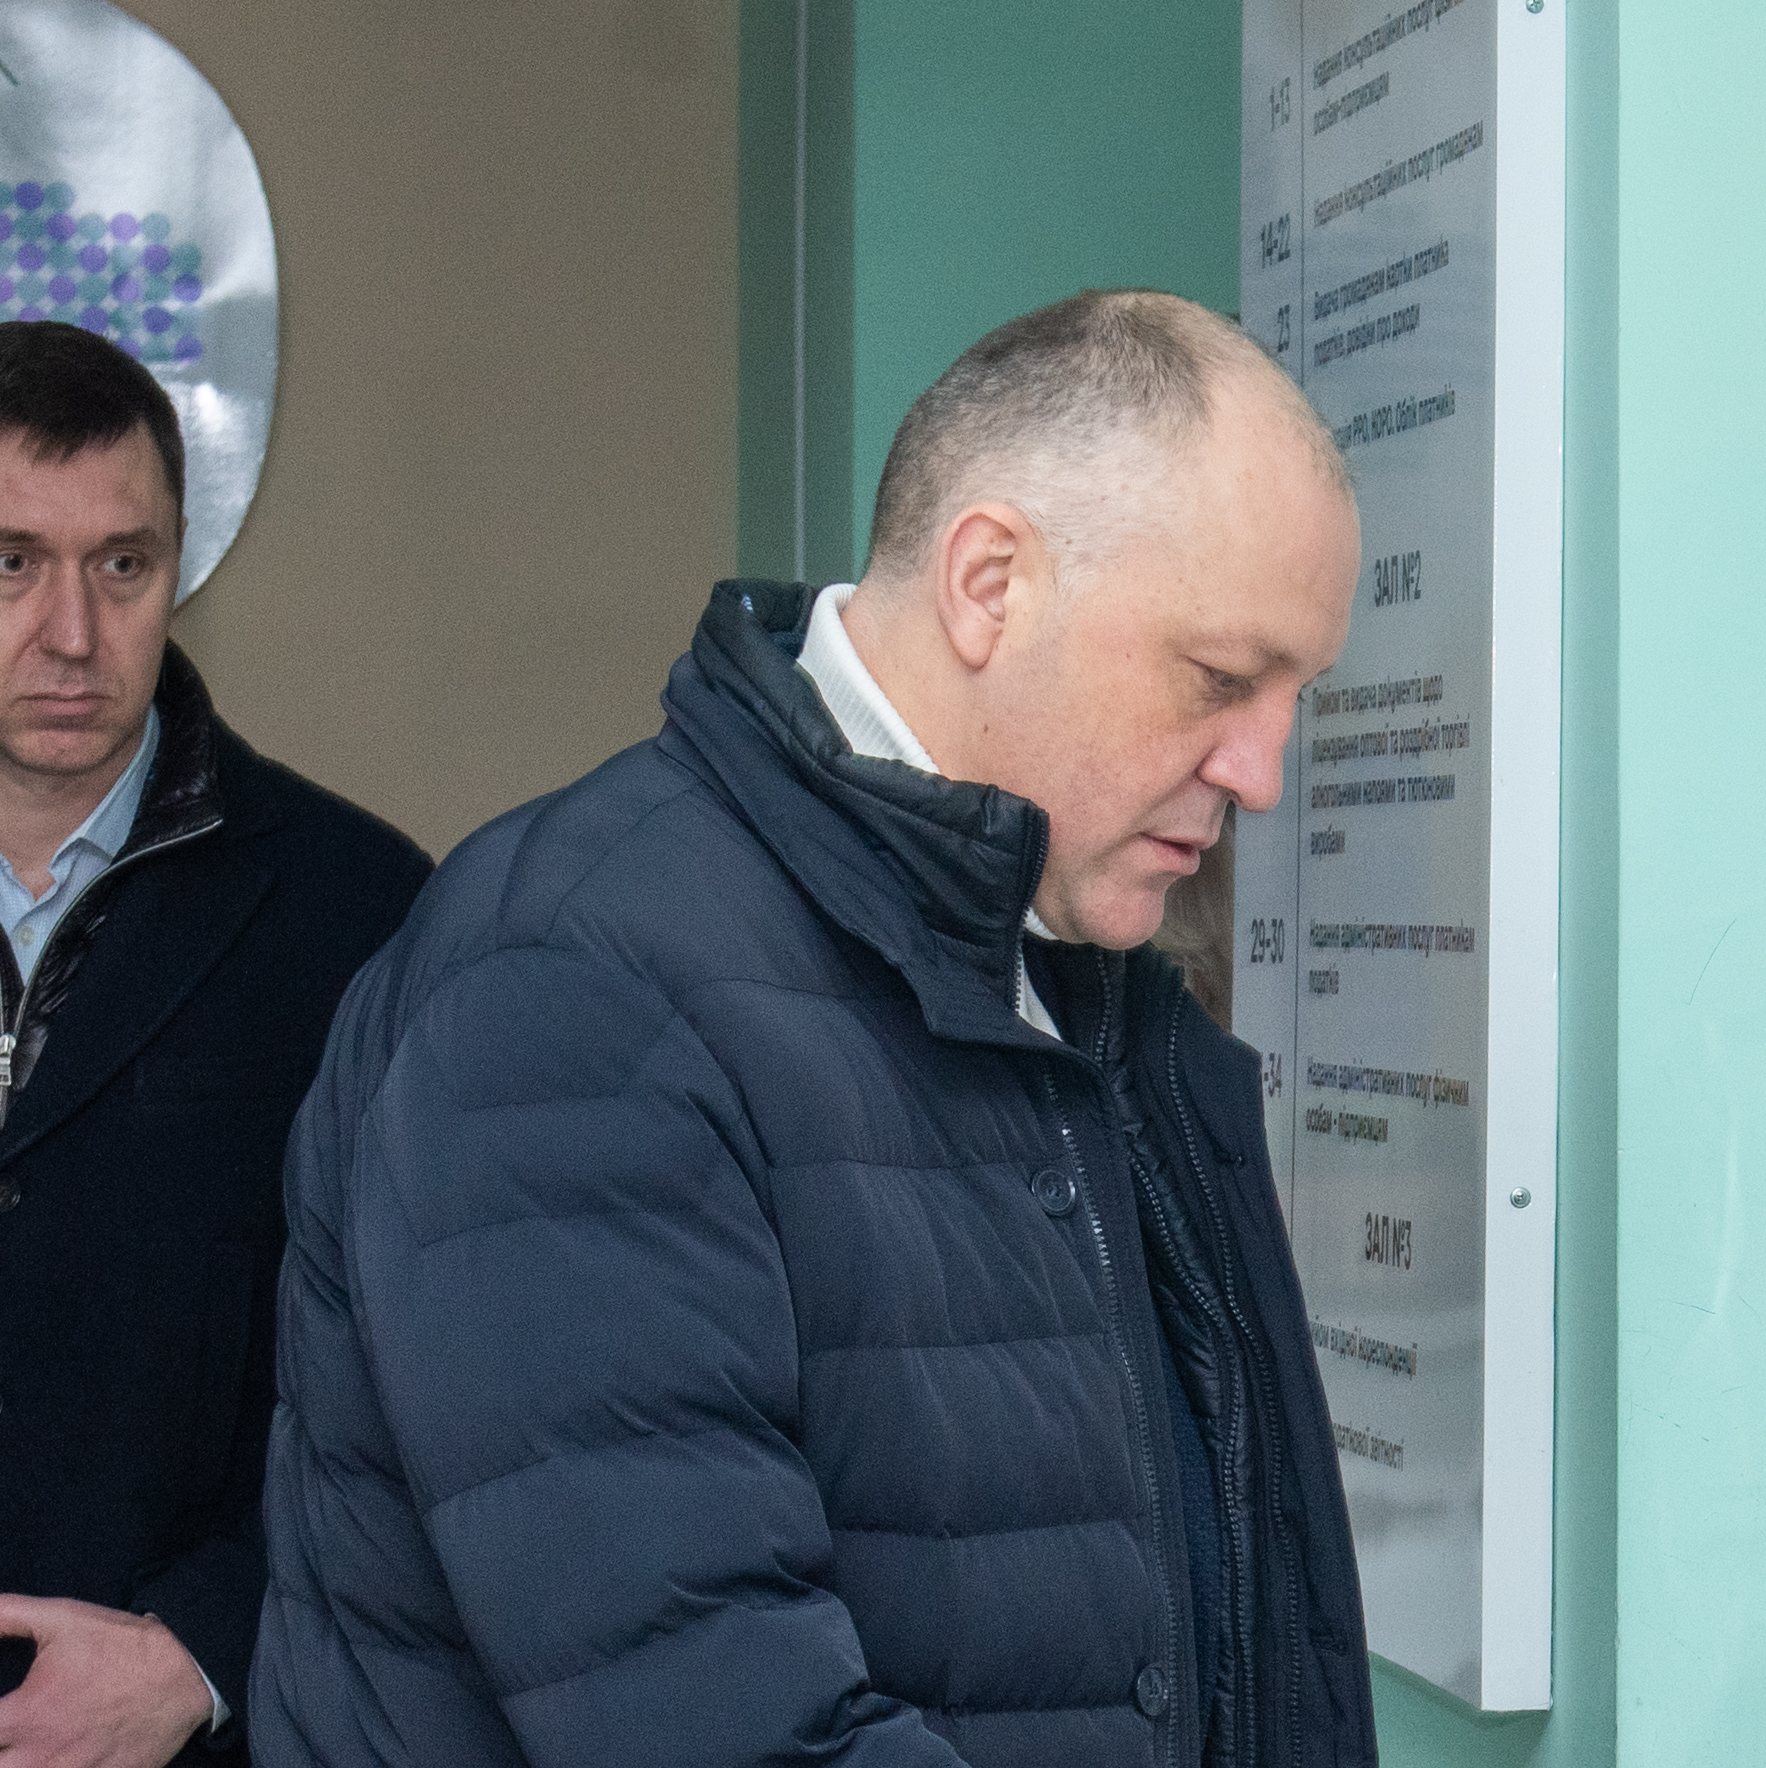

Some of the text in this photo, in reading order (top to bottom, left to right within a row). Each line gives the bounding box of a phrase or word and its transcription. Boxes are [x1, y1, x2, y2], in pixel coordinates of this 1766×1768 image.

[1277, 304, 1290, 353] 23
[1374, 550, 1421, 607] ЗАЛ №2
[1250, 918, 1285, 964] 29-30
[1364, 1211, 1412, 1270] ЗАЛ №3
